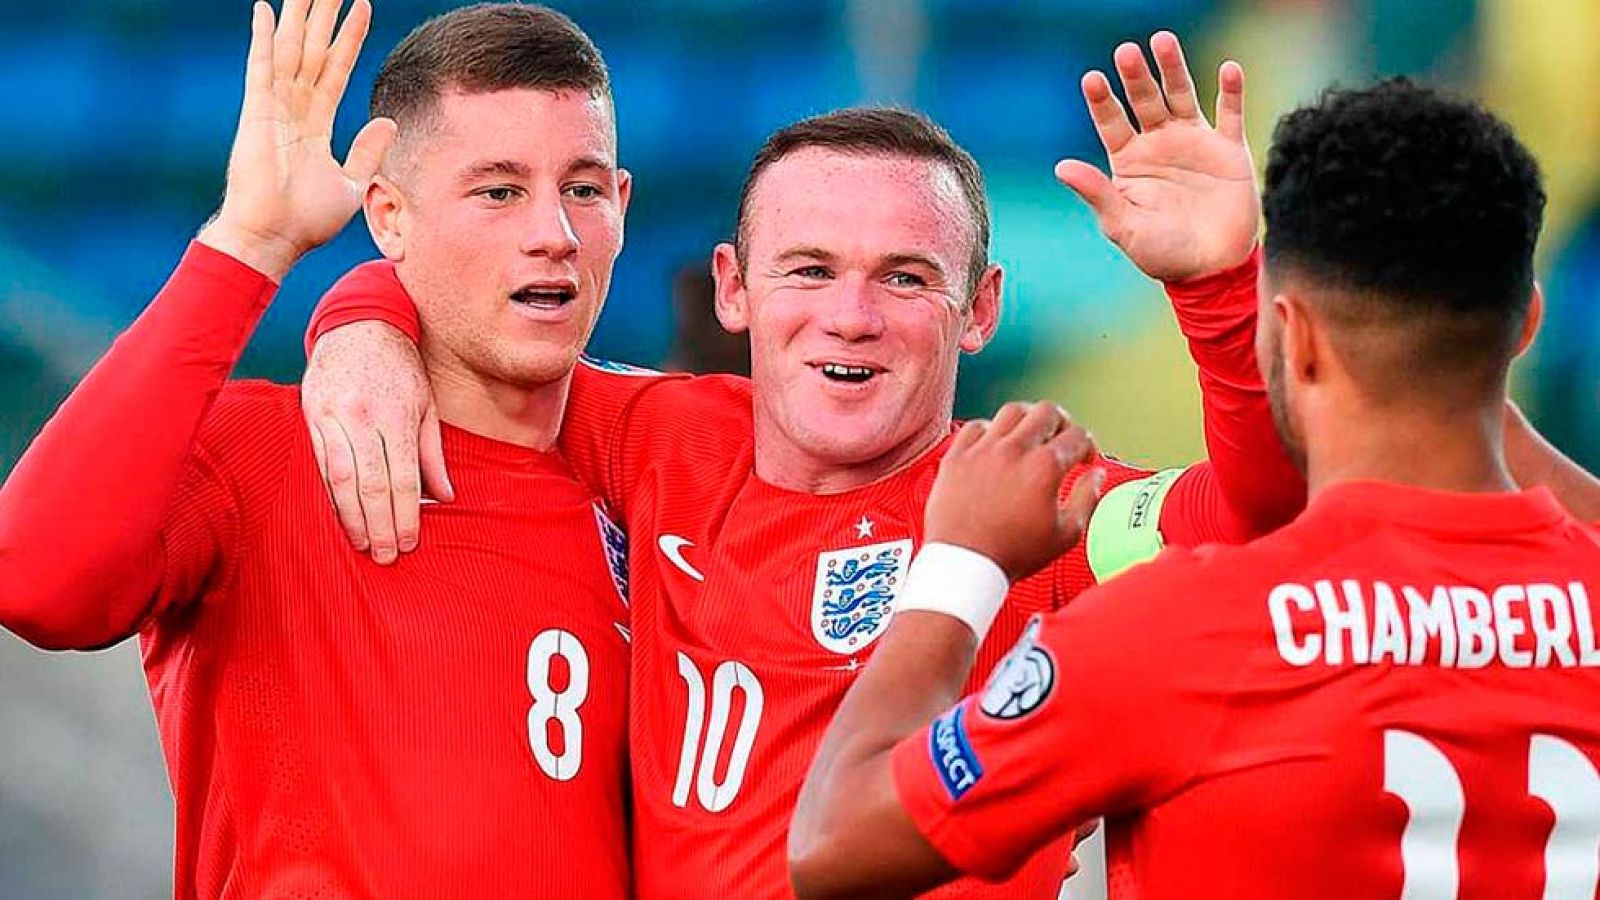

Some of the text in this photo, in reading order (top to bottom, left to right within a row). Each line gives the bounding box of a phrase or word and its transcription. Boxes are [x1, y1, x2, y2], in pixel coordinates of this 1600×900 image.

[1267, 579, 1600, 669] CHAMBERL
[526, 628, 590, 782] 8
[671, 650, 765, 814] 10
